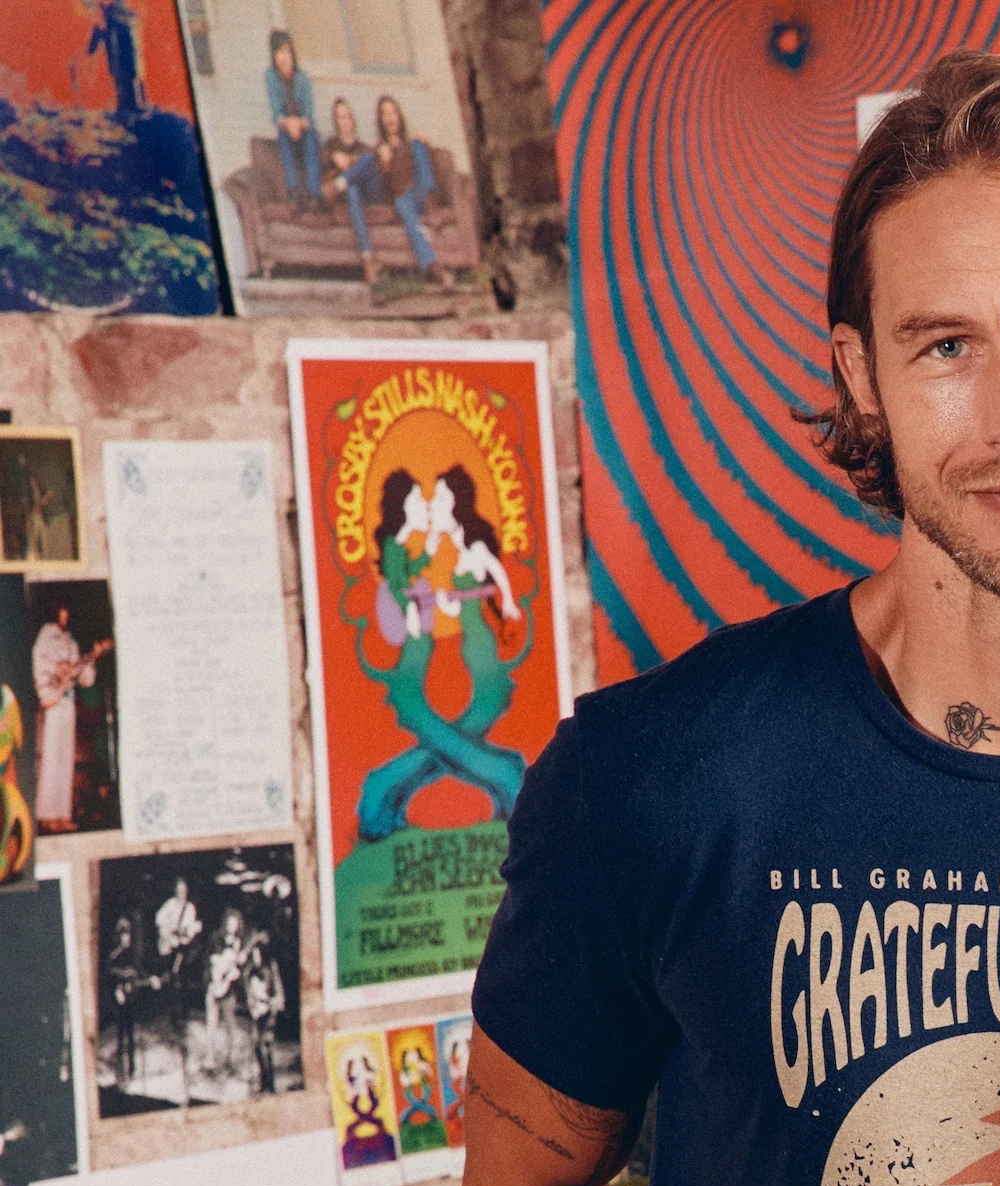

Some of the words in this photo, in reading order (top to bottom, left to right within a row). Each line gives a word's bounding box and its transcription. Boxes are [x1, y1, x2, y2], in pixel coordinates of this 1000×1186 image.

[335, 416, 376, 563] CROSBY
[363, 367, 434, 440] STILLS
[435, 368, 497, 448] NASH
[488, 434, 528, 553] YOUNG
[770, 868, 843, 891] BILL
